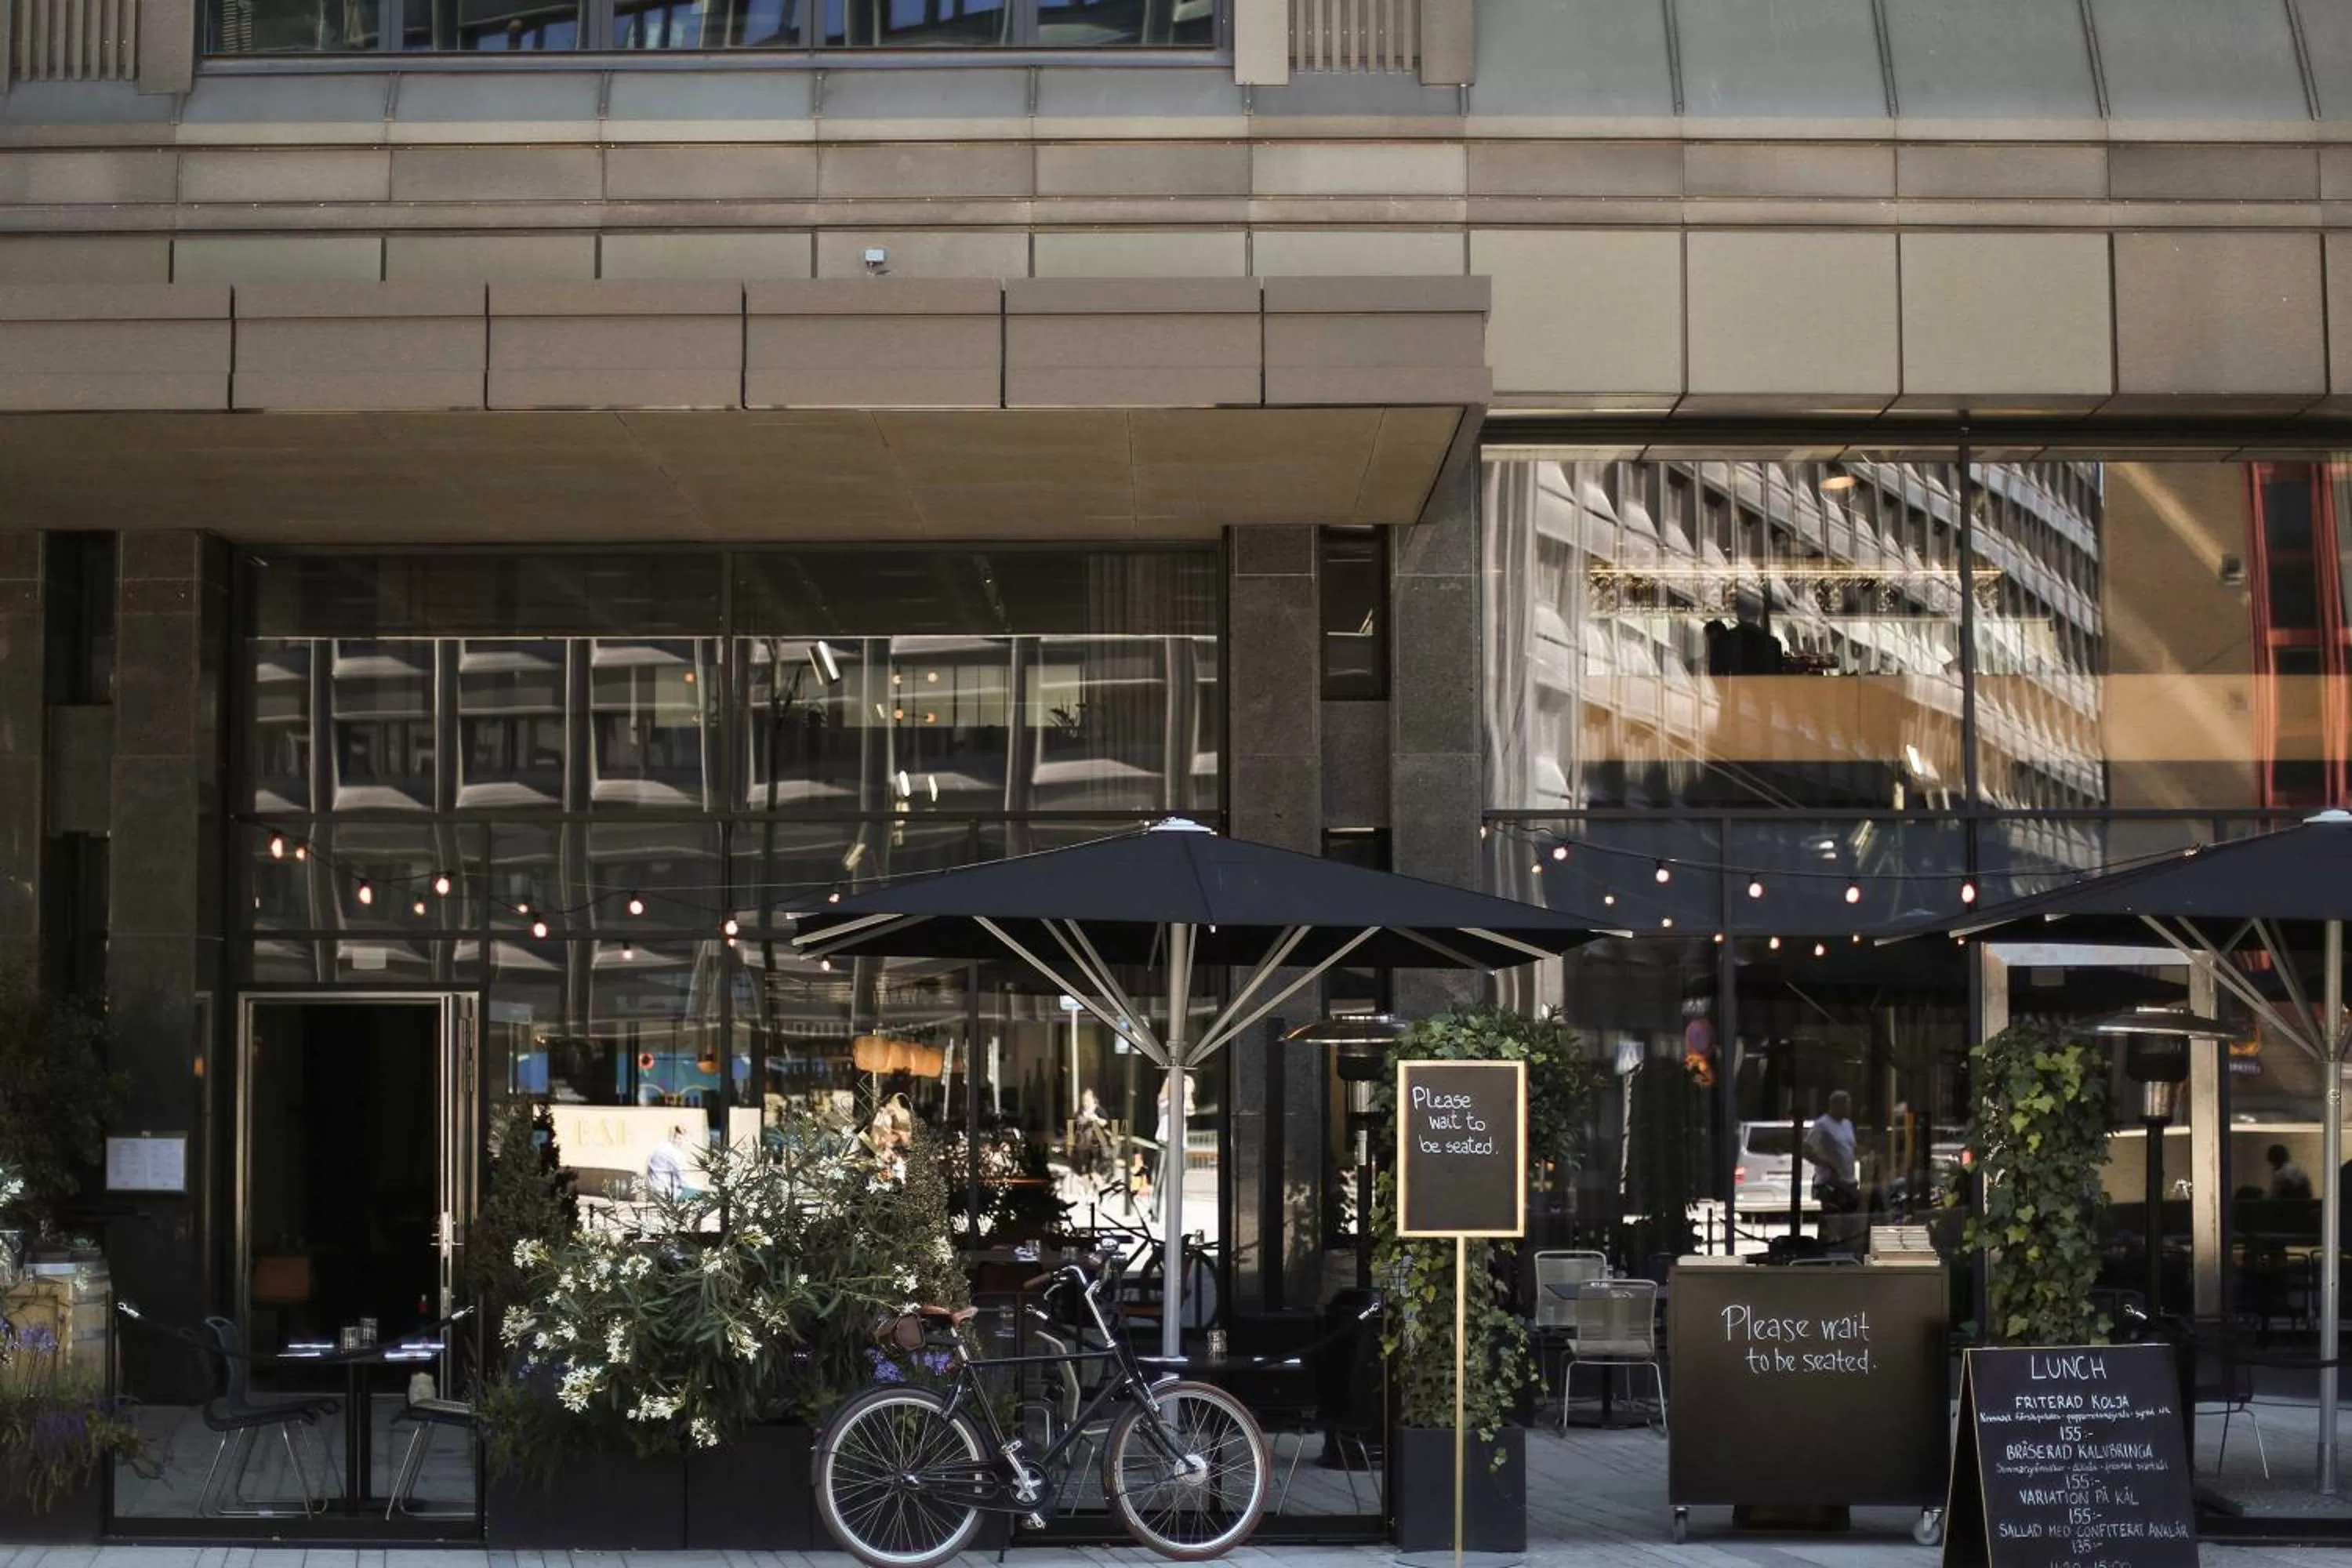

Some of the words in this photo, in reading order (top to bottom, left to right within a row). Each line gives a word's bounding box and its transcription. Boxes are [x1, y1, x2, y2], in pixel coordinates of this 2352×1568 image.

[1412, 1086, 1472, 1109] Please
[1428, 1110, 1462, 1130] wait
[1466, 1111, 1486, 1131] to
[1419, 1134, 1442, 1153] be
[1446, 1136, 1498, 1155] seated.
[1721, 1304, 1811, 1343] Please
[1820, 1311, 1870, 1341] wait
[1802, 1348, 1877, 1374] seated.
[2031, 1355, 2107, 1380] LUNCH
[2015, 1395, 2083, 1409] FRITERAD
[2091, 1394, 2130, 1410] KOLJA
[2078, 1444, 2153, 1460] KALVBRINGA
[2019, 1490, 2089, 1505] VARIATION
[2095, 1486, 2110, 1504] PÅ
[2114, 1486, 2139, 1505] KÅL
[1999, 1523, 2042, 1537] SALLAD
[2049, 1524, 2071, 1537] MED
